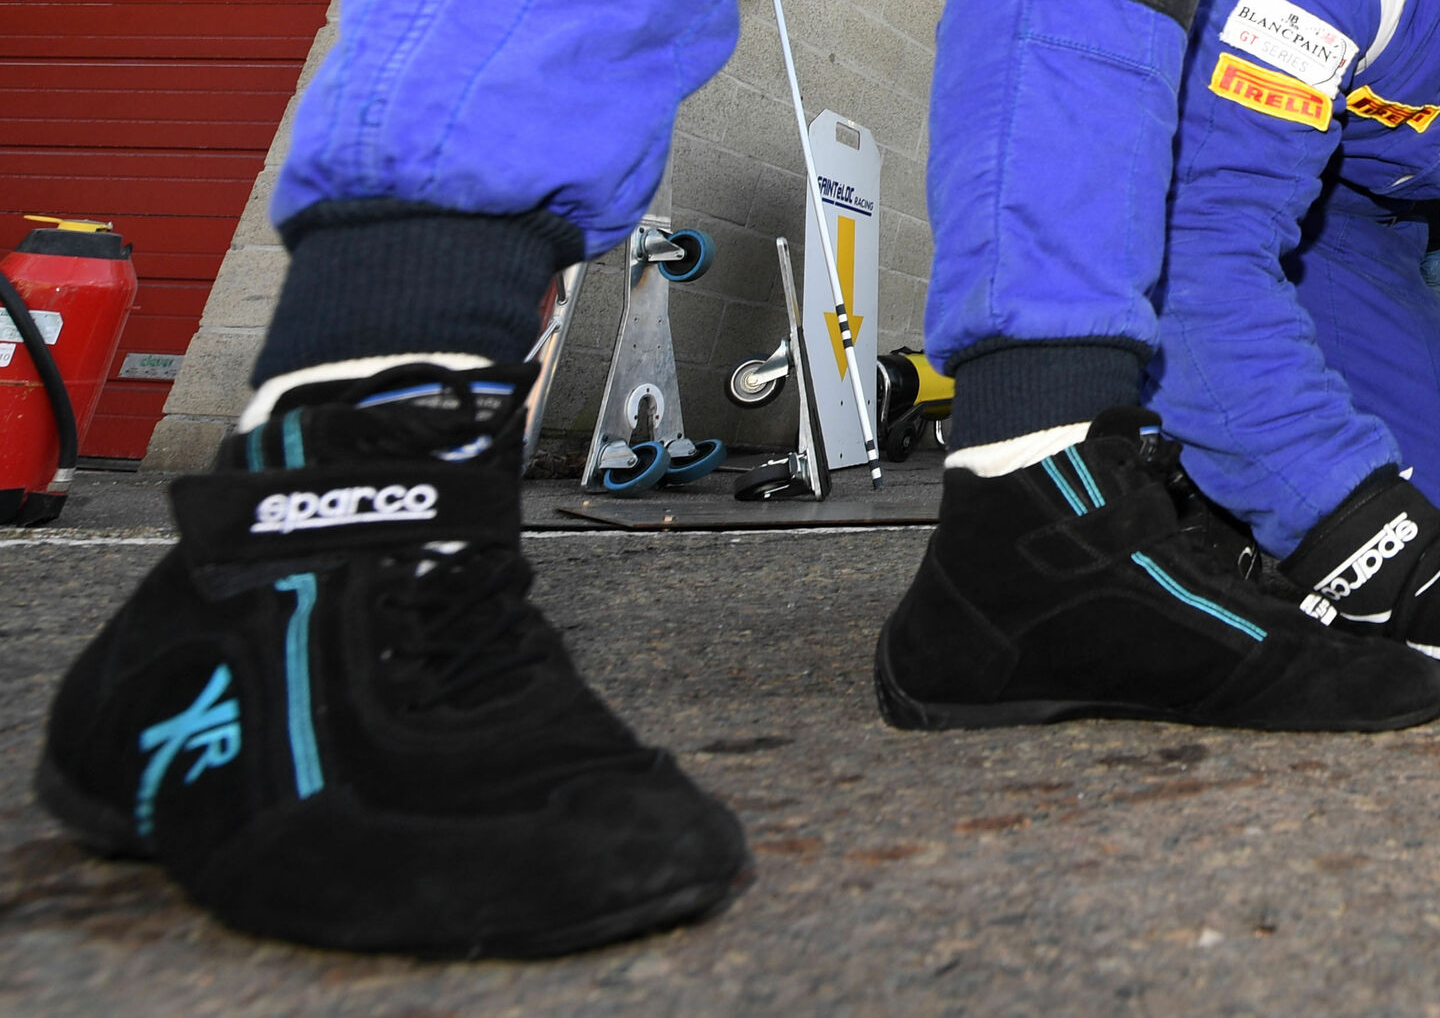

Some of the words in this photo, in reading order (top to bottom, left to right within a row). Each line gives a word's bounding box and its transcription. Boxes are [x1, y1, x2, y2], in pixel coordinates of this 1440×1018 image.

[1238, 6, 1333, 62] BLANCPAIN
[1240, 30, 1259, 45] GT
[1262, 41, 1309, 73] SERIES
[1219, 64, 1324, 119] PIRELLI
[853, 196, 874, 211] RACING
[253, 483, 438, 534] sparco
[1314, 512, 1419, 603] sparco
